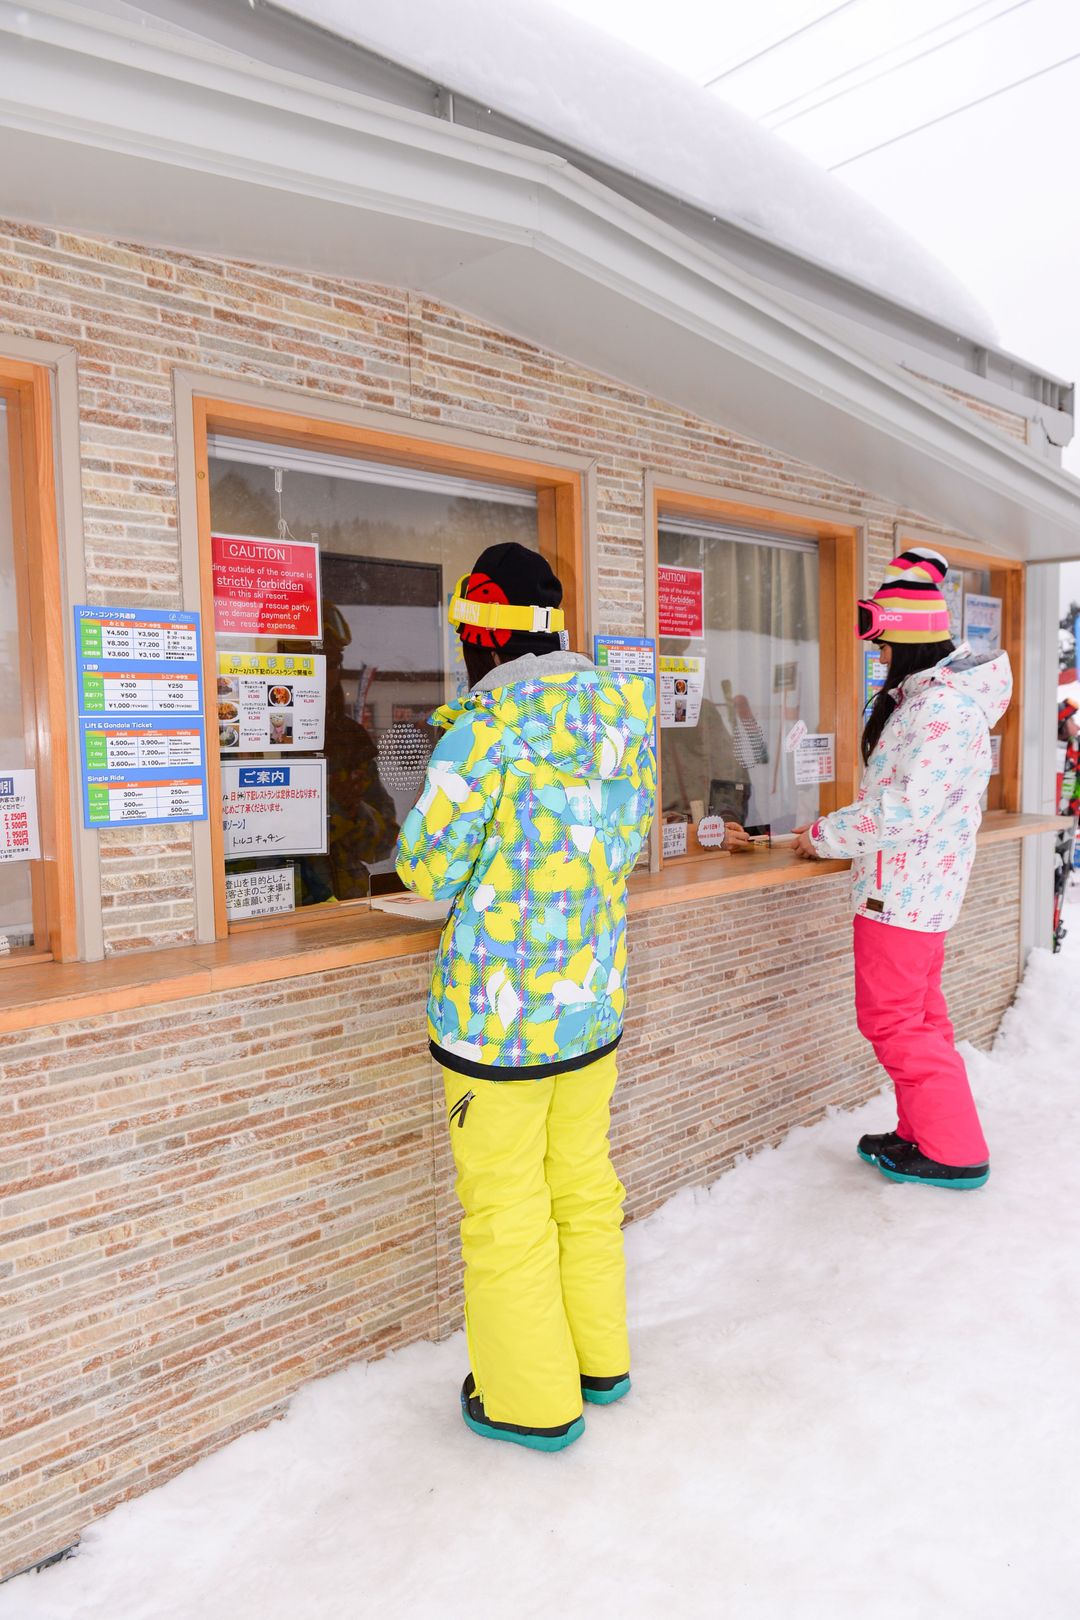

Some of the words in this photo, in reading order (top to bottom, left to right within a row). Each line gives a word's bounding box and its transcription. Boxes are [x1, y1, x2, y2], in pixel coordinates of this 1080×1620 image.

[229, 544, 286, 561] CAUTION
[229, 565, 255, 574] outside
[267, 568, 279, 576] the
[281, 570, 305, 578] course
[217, 575, 253, 588] strictly
[256, 577, 304, 591] forbidden
[238, 589, 251, 598] this
[254, 591, 264, 599] ski
[266, 592, 289, 600] resort.
[670, 594, 695, 605] forbidden
[214, 600, 228, 608] you
[230, 600, 257, 609] request
[231, 609, 259, 618] demand
[261, 612, 291, 621] payment
[240, 620, 264, 628] rescue
[266, 622, 297, 630] expense.
[244, 770, 284, 784] ご案内
[226, 874, 287, 888] 登山を目的とした
